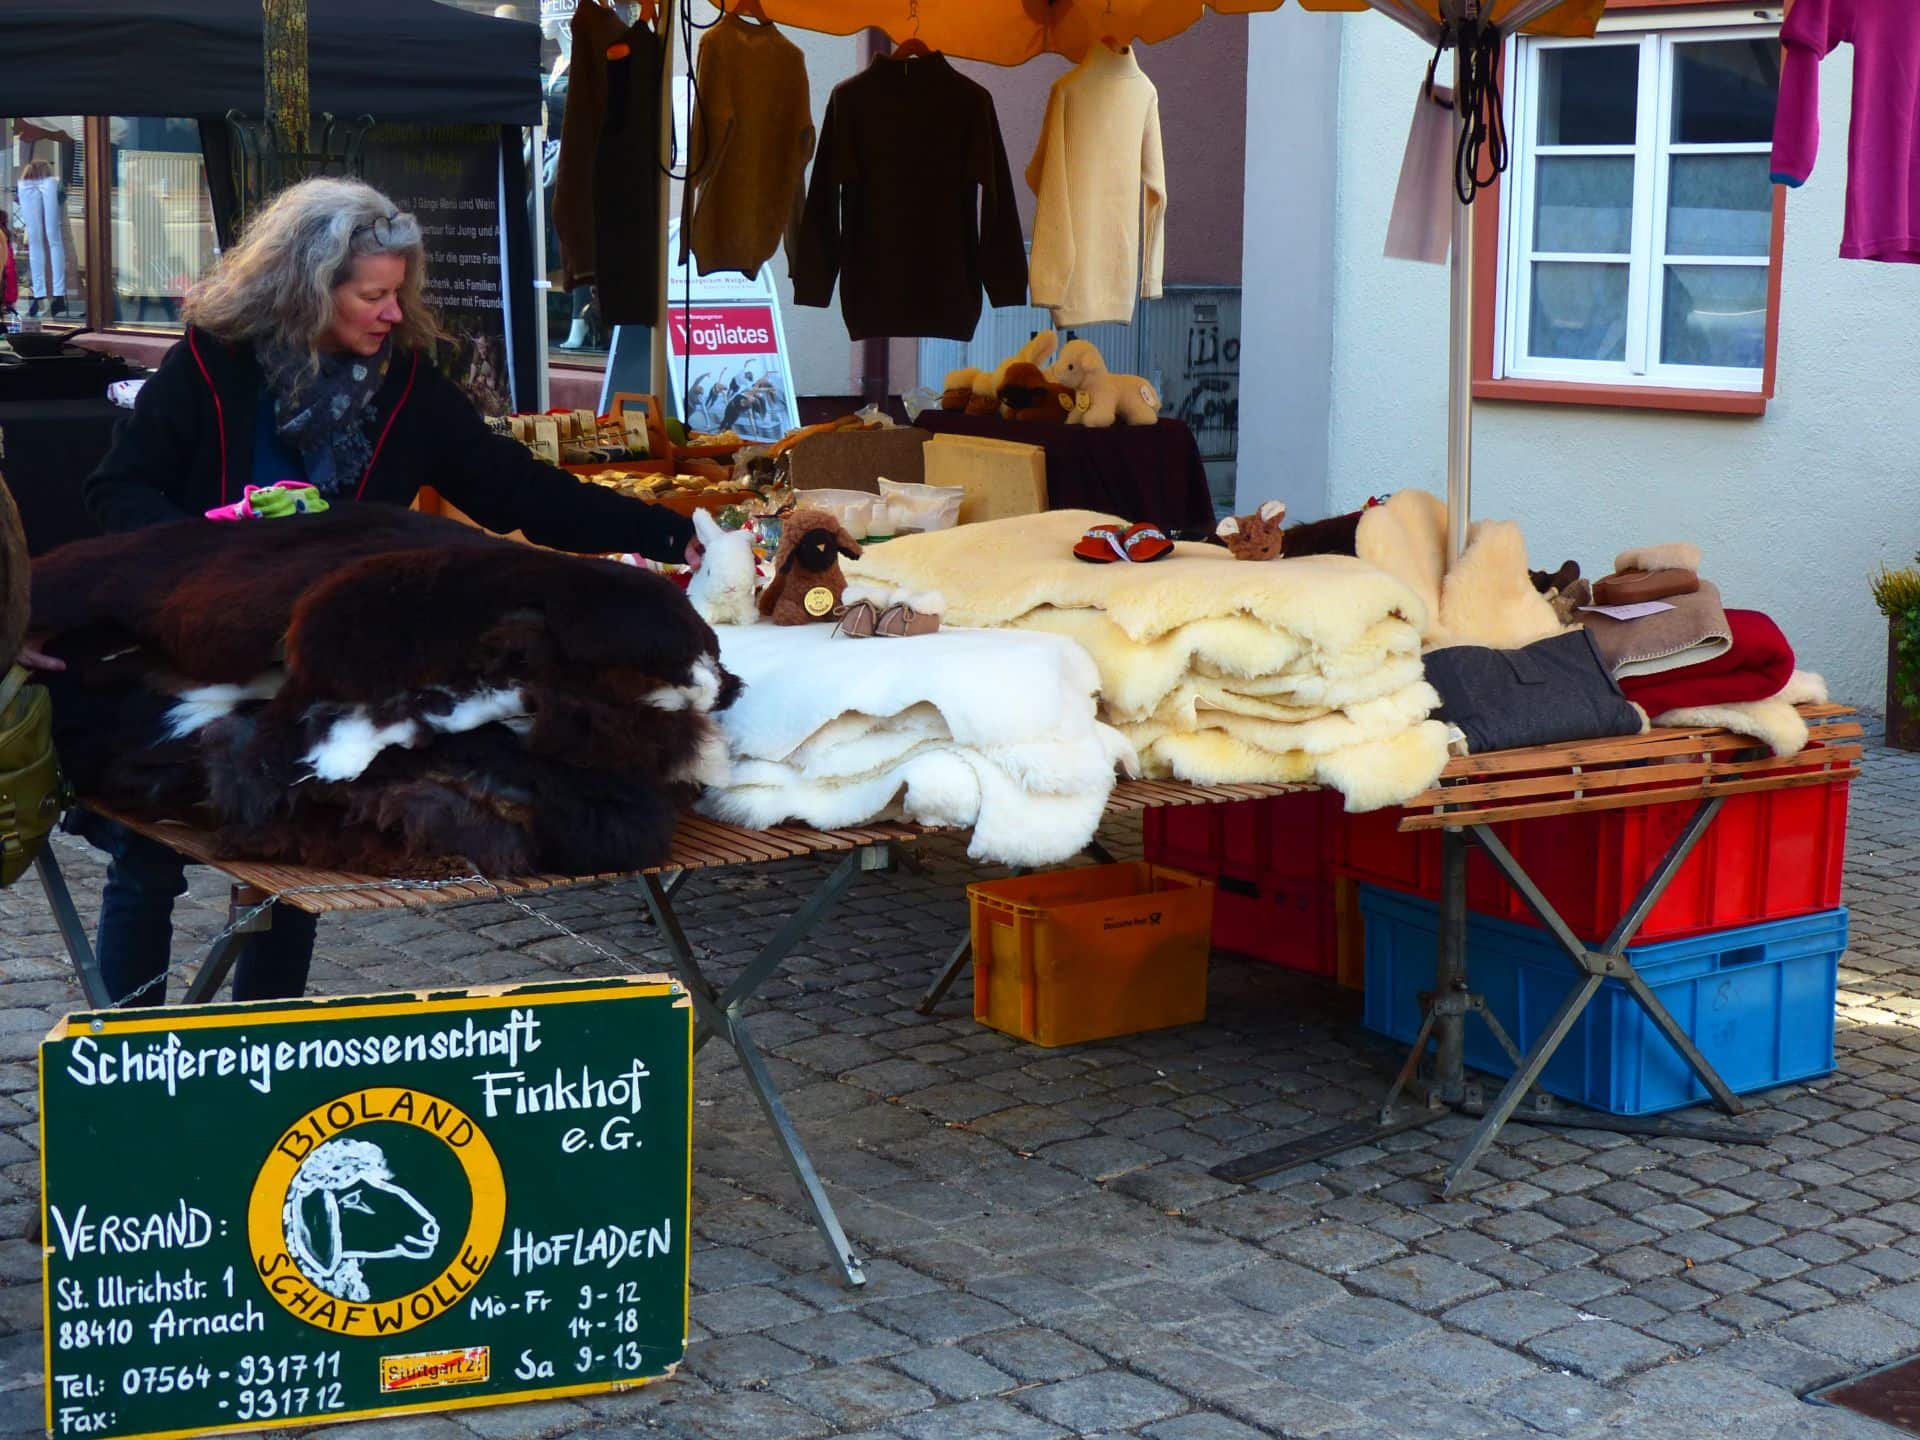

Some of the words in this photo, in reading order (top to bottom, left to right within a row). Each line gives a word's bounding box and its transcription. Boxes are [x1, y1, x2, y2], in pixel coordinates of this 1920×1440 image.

[459, 198, 474, 210] und
[475, 198, 496, 210] Wein
[457, 226, 477, 240] Jung
[478, 226, 493, 238] und
[446, 252, 458, 264] die
[459, 254, 482, 266] ganze
[444, 295, 460, 307] oder
[462, 296, 474, 308] mit
[454, 280, 465, 291] als
[466, 279, 497, 292] Familien
[676, 323, 769, 351] Yogilates
[67, 1008, 543, 1096] Schäfereigenossenschaft
[473, 1057, 651, 1118] Finkhof
[277, 1091, 475, 1162] BIOLAND
[561, 1116, 643, 1153] e.G.
[50, 1198, 228, 1262] VERSAND:
[505, 1217, 672, 1277] HOFLADEN
[57, 1278, 90, 1312] St.
[97, 1268, 208, 1308] Ulrichstr.
[222, 1265, 235, 1298] 1
[258, 1244, 490, 1334] SCHAFWOLLE
[59, 1318, 134, 1350] 88410
[149, 1299, 265, 1345] Arnach
[388, 1358, 463, 1381] Stuttgart
[514, 1349, 556, 1381] Sa
[55, 1374, 106, 1400] Tel.:
[59, 1406, 118, 1435] Fax:
